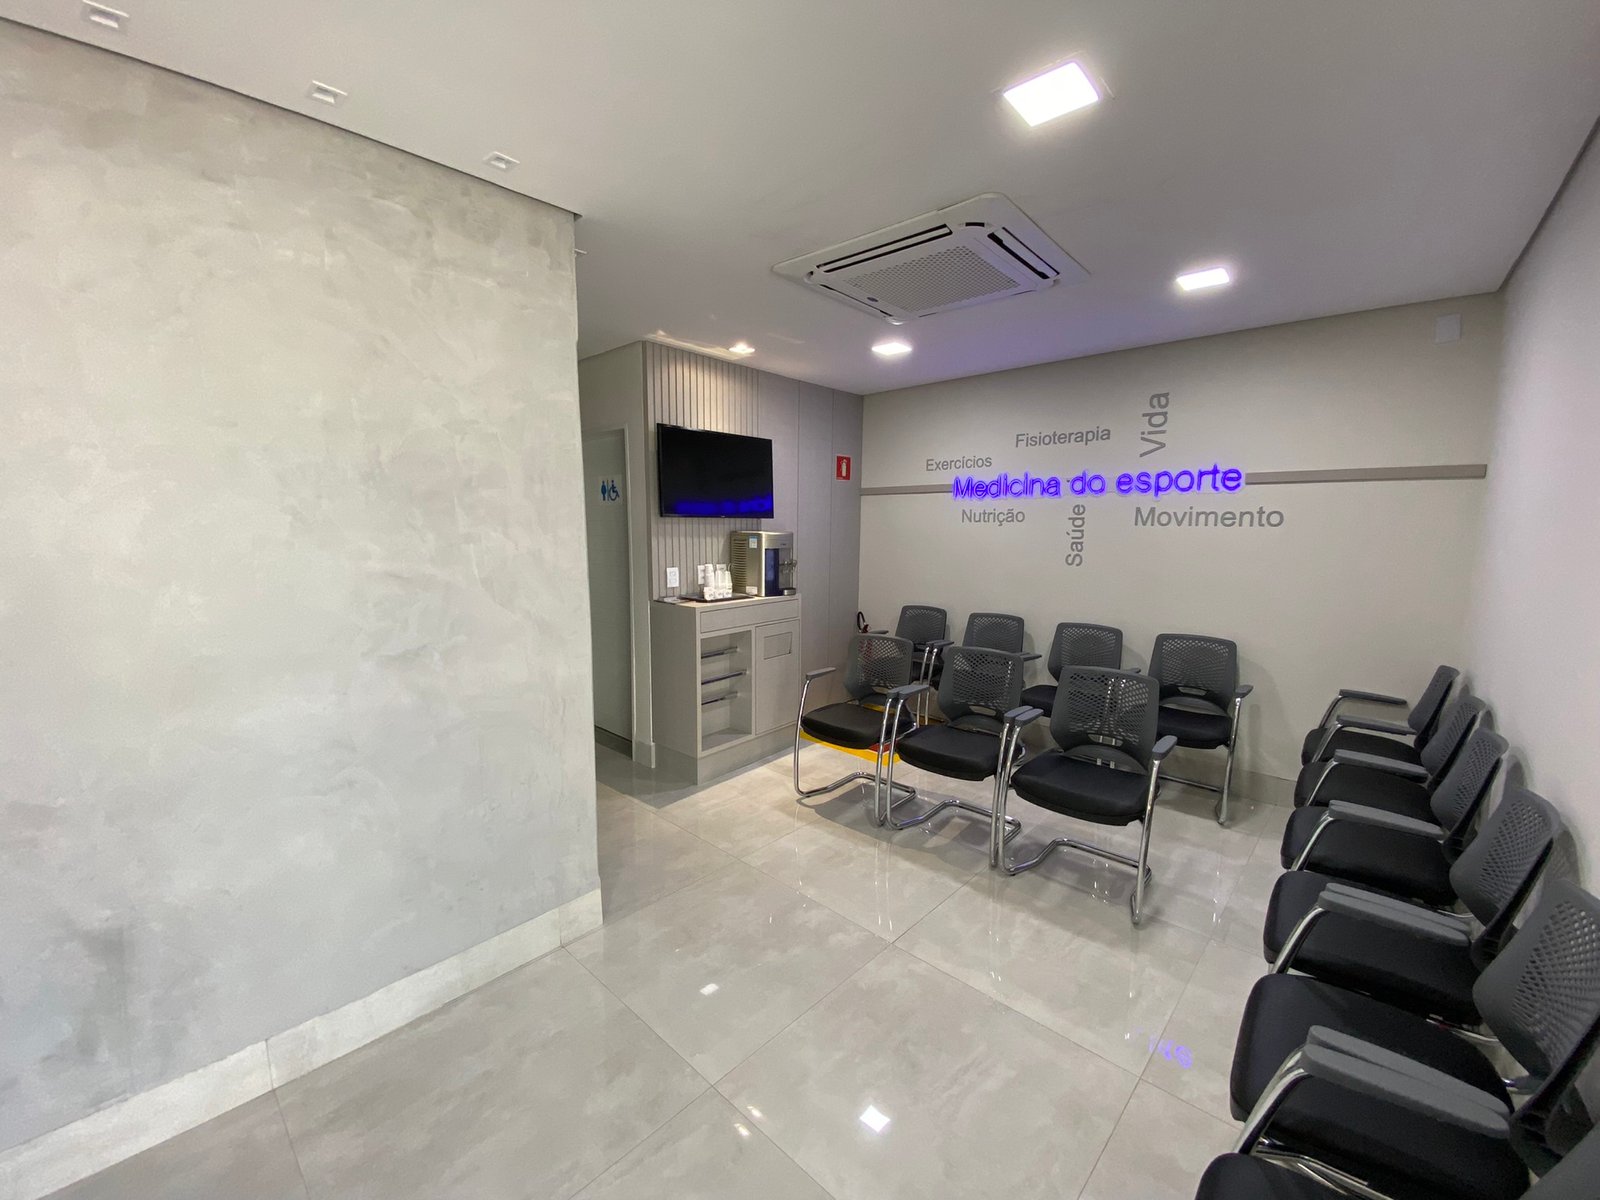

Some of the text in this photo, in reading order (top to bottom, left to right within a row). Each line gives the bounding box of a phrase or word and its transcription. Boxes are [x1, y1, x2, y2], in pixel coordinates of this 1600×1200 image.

[1139, 391, 1170, 458] Vida
[1015, 426, 1112, 448] Fisioterapia
[925, 455, 993, 472] Exercícios
[952, 463, 1244, 500] Medicina do esporte
[961, 508, 1026, 526] Nutrição
[1134, 505, 1285, 528] Movimento
[1064, 503, 1087, 567] Saúde
